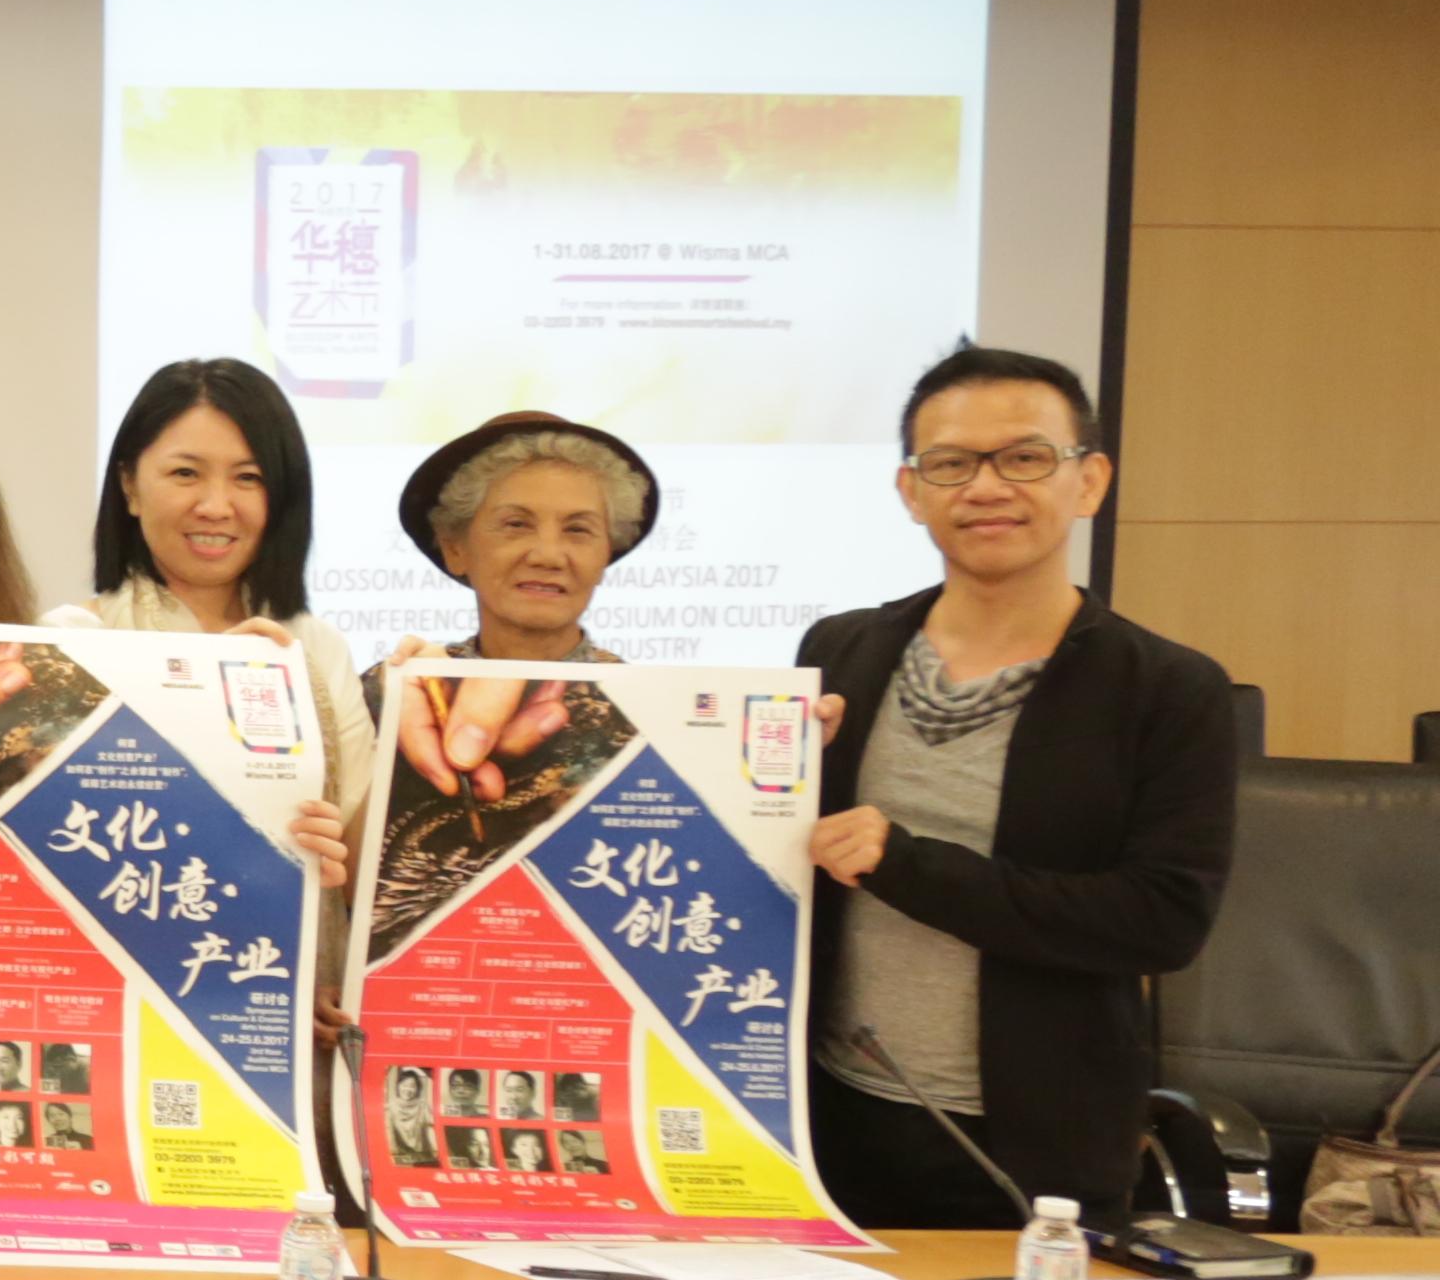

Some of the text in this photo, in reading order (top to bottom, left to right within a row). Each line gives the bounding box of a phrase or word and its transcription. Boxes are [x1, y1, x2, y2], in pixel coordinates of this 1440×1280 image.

[290, 182, 385, 206] 2017
[291, 219, 380, 275] 华穗
[533, 243, 651, 261] 1-31.08.2017
[679, 244, 741, 261] Wisma
[747, 244, 790, 261] MCA
[311, 567, 415, 593] LOSSOM
[723, 565, 779, 589] 2017
[680, 606, 718, 630] ON
[178, 931, 290, 997] 产业
[681, 964, 786, 1028] 产业
